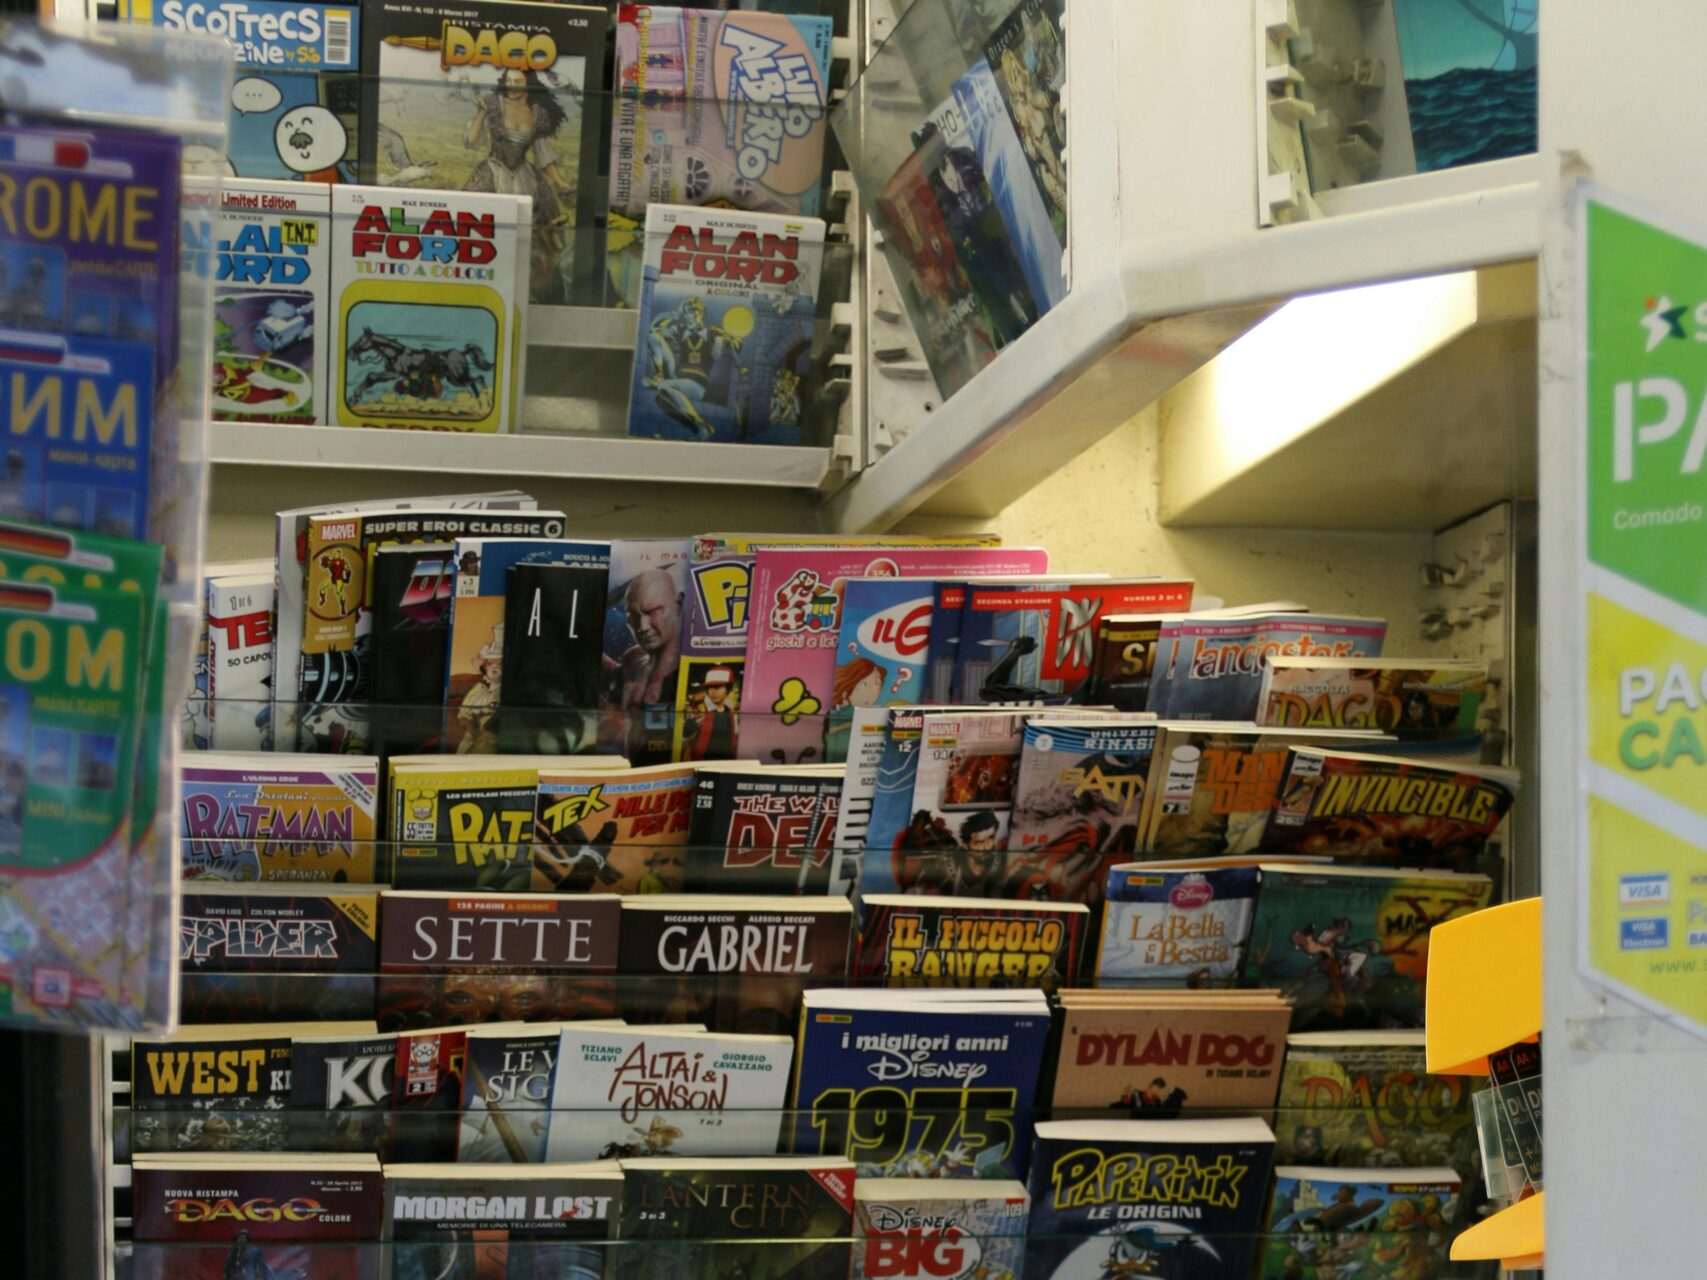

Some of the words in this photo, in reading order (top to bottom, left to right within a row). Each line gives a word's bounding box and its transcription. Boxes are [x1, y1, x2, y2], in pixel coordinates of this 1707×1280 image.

[446, 26, 557, 71] DAGO
[720, 23, 788, 181] ALBERTO
[777, 53, 823, 139] LUPO
[221, 192, 258, 209] Limited
[261, 195, 297, 210] Edition
[353, 205, 496, 239] ALAN
[352, 233, 498, 265] FORD
[662, 225, 799, 261] ALAN
[356, 260, 409, 275] TUTTO
[431, 266, 495, 281] COLORI
[659, 251, 799, 285] FORD
[365, 521, 419, 534] SUPER
[423, 520, 465, 534] EROI
[470, 520, 541, 536] CLASSIC
[1613, 503, 1703, 531] Comodo
[321, 521, 356, 541] MARVEL
[1124, 595, 1157, 603] NUMERO
[768, 635, 804, 650] giochi
[894, 715, 923, 729] MARVEL
[929, 723, 961, 737] MARVEL
[543, 783, 610, 834] TEX
[733, 794, 787, 813] THE
[1312, 771, 1503, 829] INVINCIBLE
[186, 792, 354, 860] RAT-MAN
[1176, 887, 1211, 902] Disney
[1627, 884, 1662, 899] VISA
[412, 916, 592, 962] SETTE
[890, 916, 926, 950] IL
[938, 919, 1064, 952] PICCOLO
[1131, 914, 1163, 940] La
[1167, 915, 1226, 940] Bella
[1631, 921, 1655, 932] VISA
[657, 925, 814, 973] GABRIEL
[1157, 943, 1229, 967] Bestia
[1622, 935, 1666, 949] Electron
[886, 951, 1062, 989] RANGER
[581, 1044, 622, 1055] TIZIANO
[856, 1033, 949, 1056] migliori
[955, 1035, 1010, 1052] anni
[1077, 1030, 1192, 1068] DYLAN
[1197, 1032, 1276, 1066] DOG
[147, 1049, 266, 1095] WEST
[503, 1052, 533, 1074] LE
[866, 1050, 988, 1089] Disney
[620, 1073, 728, 1125] JONSON
[1300, 1074, 1462, 1146] DAGO
[811, 1086, 1018, 1168] 1975
[1052, 1148, 1249, 1212] PAPERINIK
[164, 1189, 194, 1198] NUOVA
[196, 1189, 239, 1198] RISTAMPA
[639, 1184, 813, 1209] LANTERN
[173, 1197, 322, 1223] DAGO
[318, 1214, 352, 1224] COLORE
[393, 1195, 517, 1220] MORGAN
[534, 1196, 612, 1220] LOST
[729, 1204, 814, 1230] CITY
[1004, 1203, 1024, 1218] 109
[1087, 1206, 1113, 1220] LE
[1116, 1205, 1204, 1220] ORIGINI
[869, 1204, 958, 1238] Disney
[863, 1228, 966, 1278] BIG
